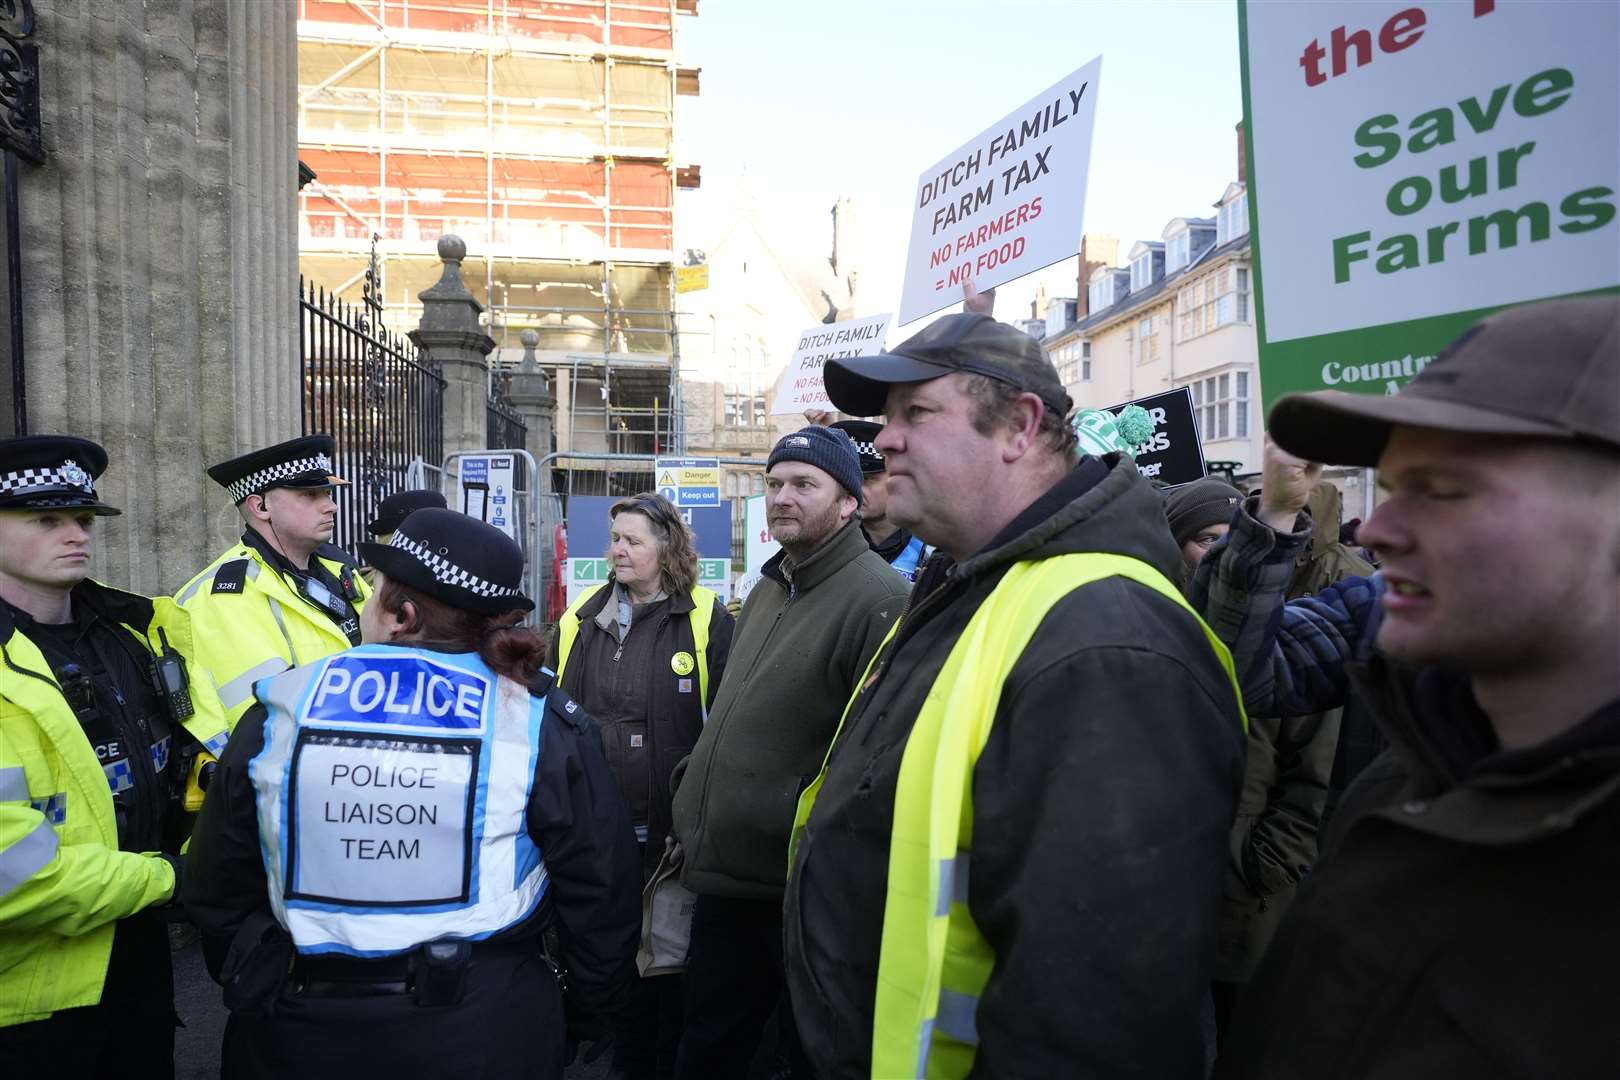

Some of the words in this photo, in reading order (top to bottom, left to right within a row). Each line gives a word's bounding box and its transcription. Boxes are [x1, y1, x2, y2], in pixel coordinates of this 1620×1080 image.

[1300, 7, 1427, 88] the
[1353, 67, 1575, 169] Save
[919, 148, 982, 209] DITCH
[988, 81, 1088, 166] FAMILY
[932, 179, 994, 235] FARM
[1002, 145, 1052, 196] TAX
[1386, 140, 1537, 217] our
[930, 243, 952, 269] NO
[956, 196, 1043, 257] FARMERS
[1332, 186, 1617, 285] Farms
[948, 262, 971, 288] NO
[976, 236, 1025, 276] FOOD
[798, 332, 834, 351] DITCH
[834, 323, 884, 344] FAMILY
[793, 378, 807, 390] NO
[1321, 353, 1438, 385] Countr
[799, 392, 813, 404] NO
[682, 491, 702, 500] Keep
[684, 471, 712, 479] Danger
[313, 667, 483, 720] POLICE
[330, 764, 438, 789] POLICE
[324, 801, 438, 825] LIAISON
[340, 838, 420, 860] TEAM
